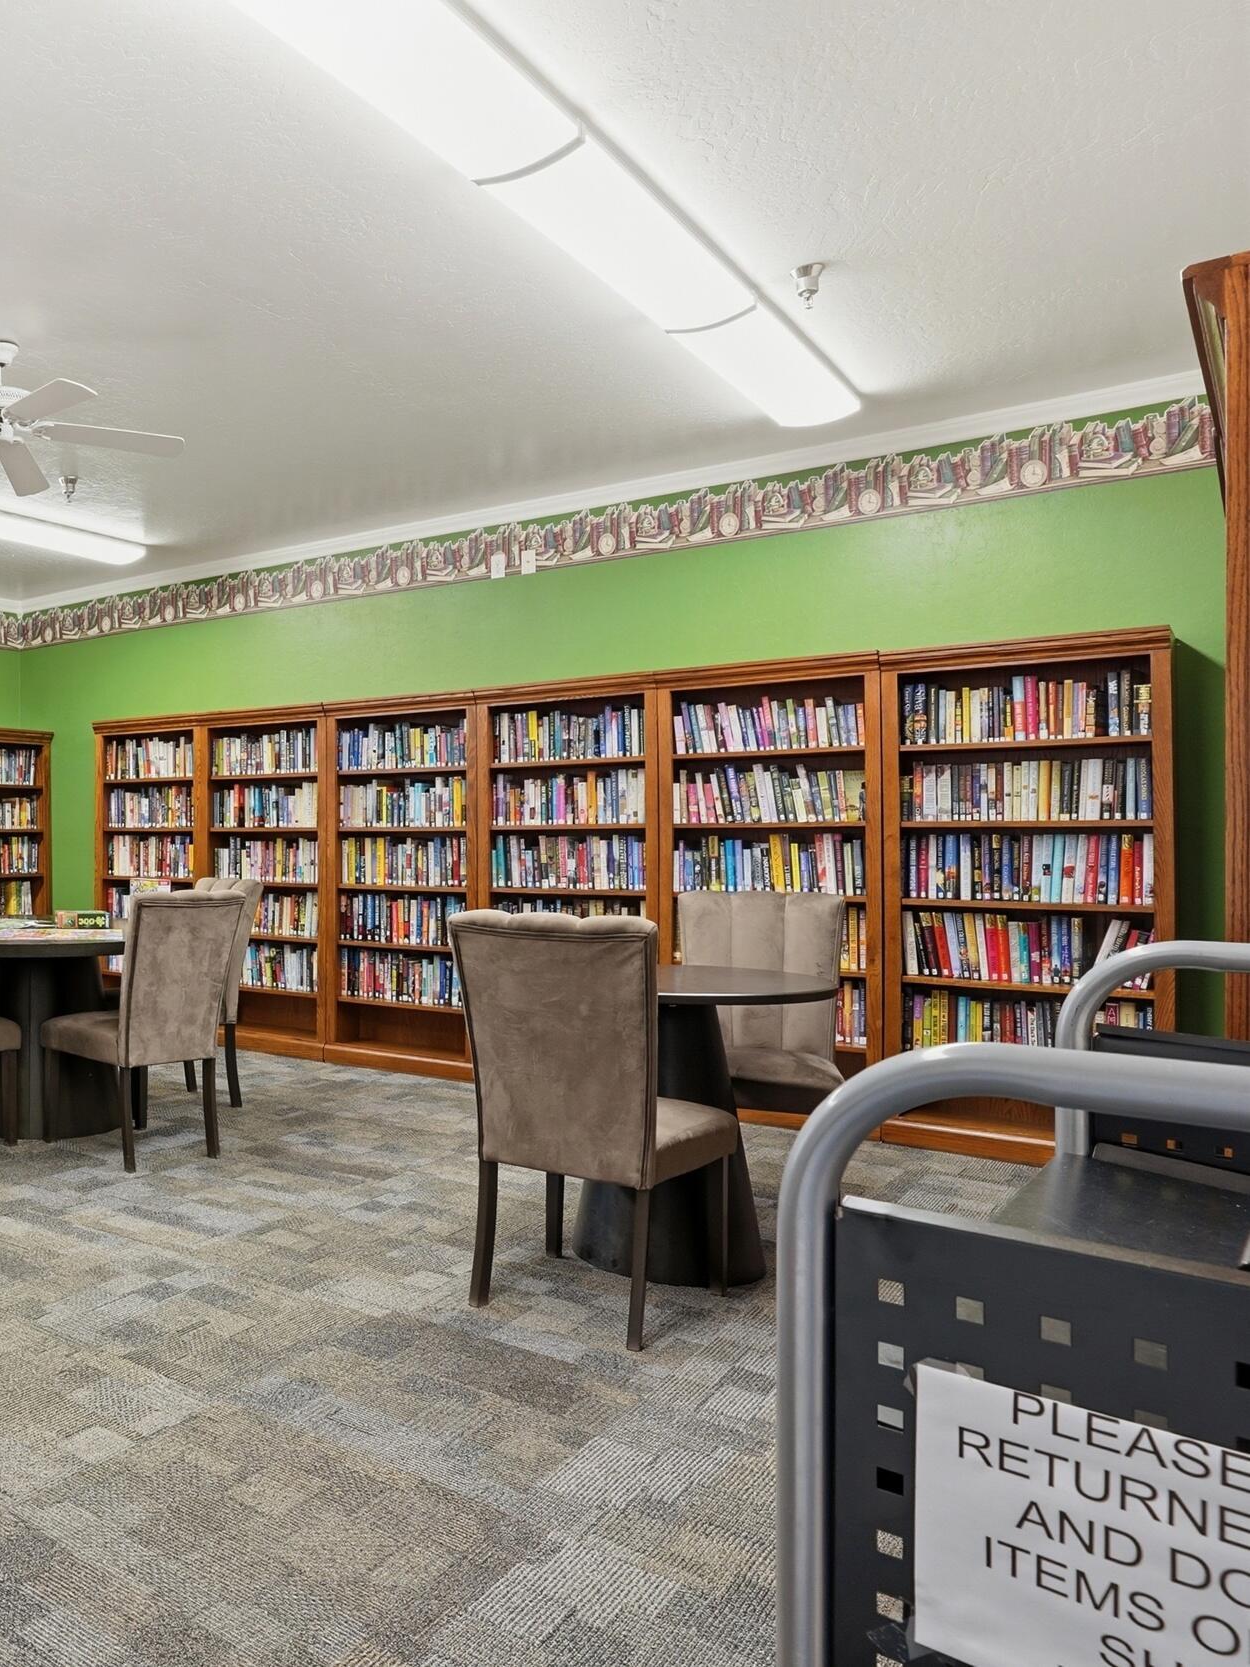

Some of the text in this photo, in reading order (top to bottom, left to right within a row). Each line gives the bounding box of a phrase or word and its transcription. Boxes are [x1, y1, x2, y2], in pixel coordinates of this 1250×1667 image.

[958, 1426, 1250, 1551] RETURNE
[1013, 1391, 1250, 1494] PLEASE
[1016, 1501, 1143, 1568] AND
[985, 1536, 1250, 1660] ITEMS O
